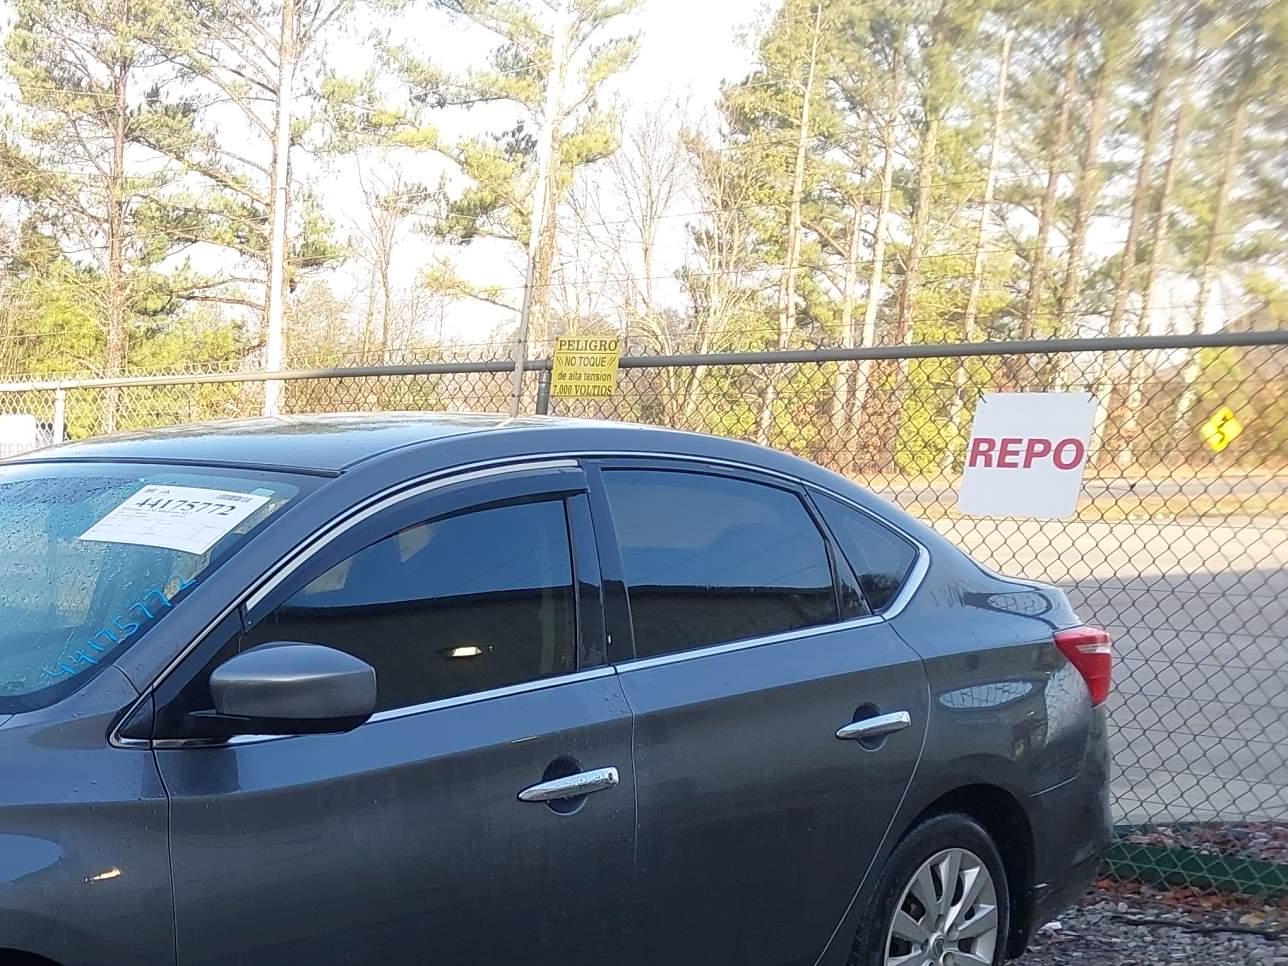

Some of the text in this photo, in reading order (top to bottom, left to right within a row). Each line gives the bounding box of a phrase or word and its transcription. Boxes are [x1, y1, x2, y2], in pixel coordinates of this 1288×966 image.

[558, 339, 618, 352] PELIGRO
[564, 356, 607, 367] NO TOQUE
[557, 371, 567, 381] de
[568, 371, 582, 381] alta
[574, 384, 613, 397] VOLTIOS
[968, 437, 1085, 470] REPO
[135, 497, 237, 516] 44175772
[45, 574, 197, 677] 44175772
